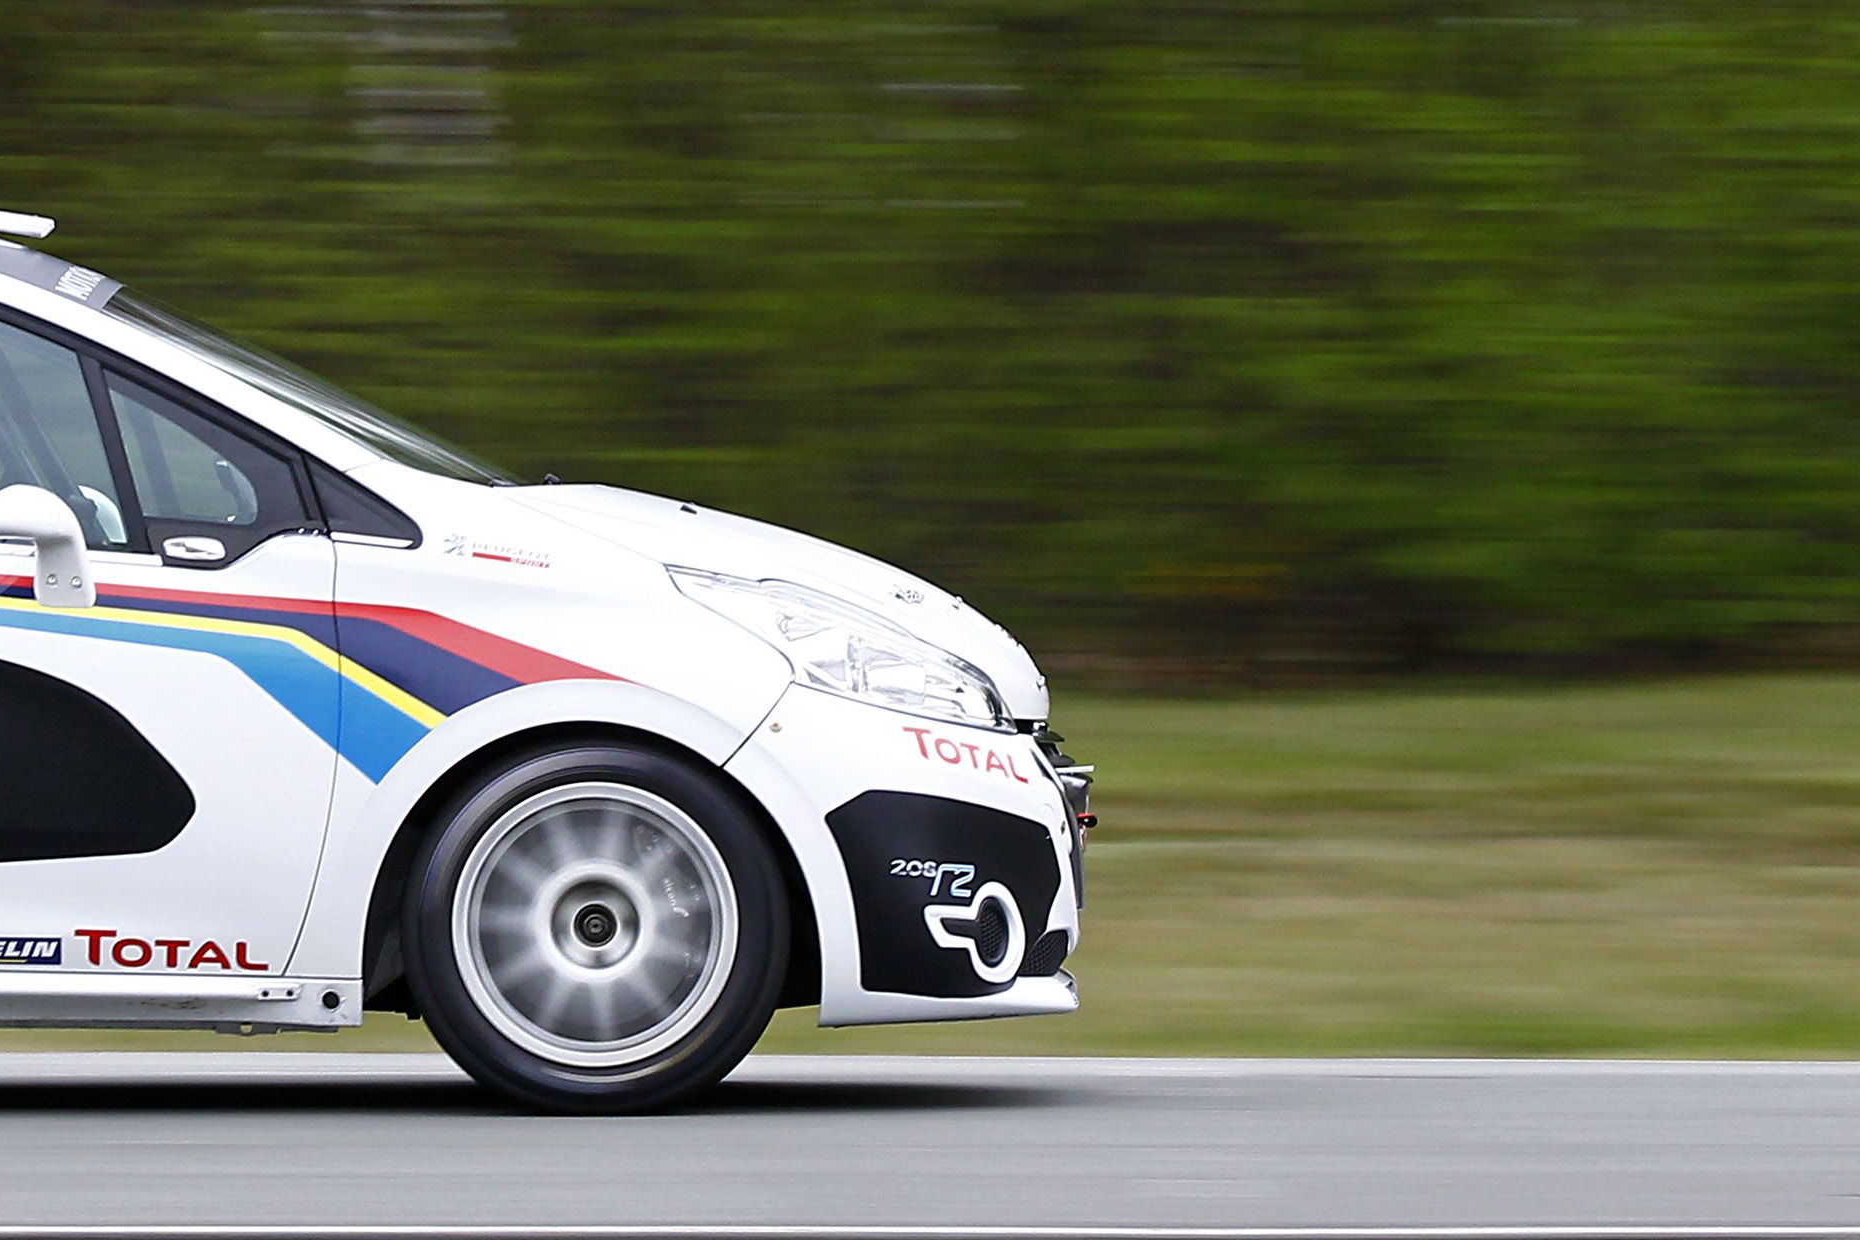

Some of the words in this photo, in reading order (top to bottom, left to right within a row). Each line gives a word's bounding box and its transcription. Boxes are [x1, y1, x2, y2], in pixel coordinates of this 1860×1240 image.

[902, 726, 1029, 784] TOTAL
[890, 859, 937, 878] 208
[74, 928, 269, 971] TOTAL
